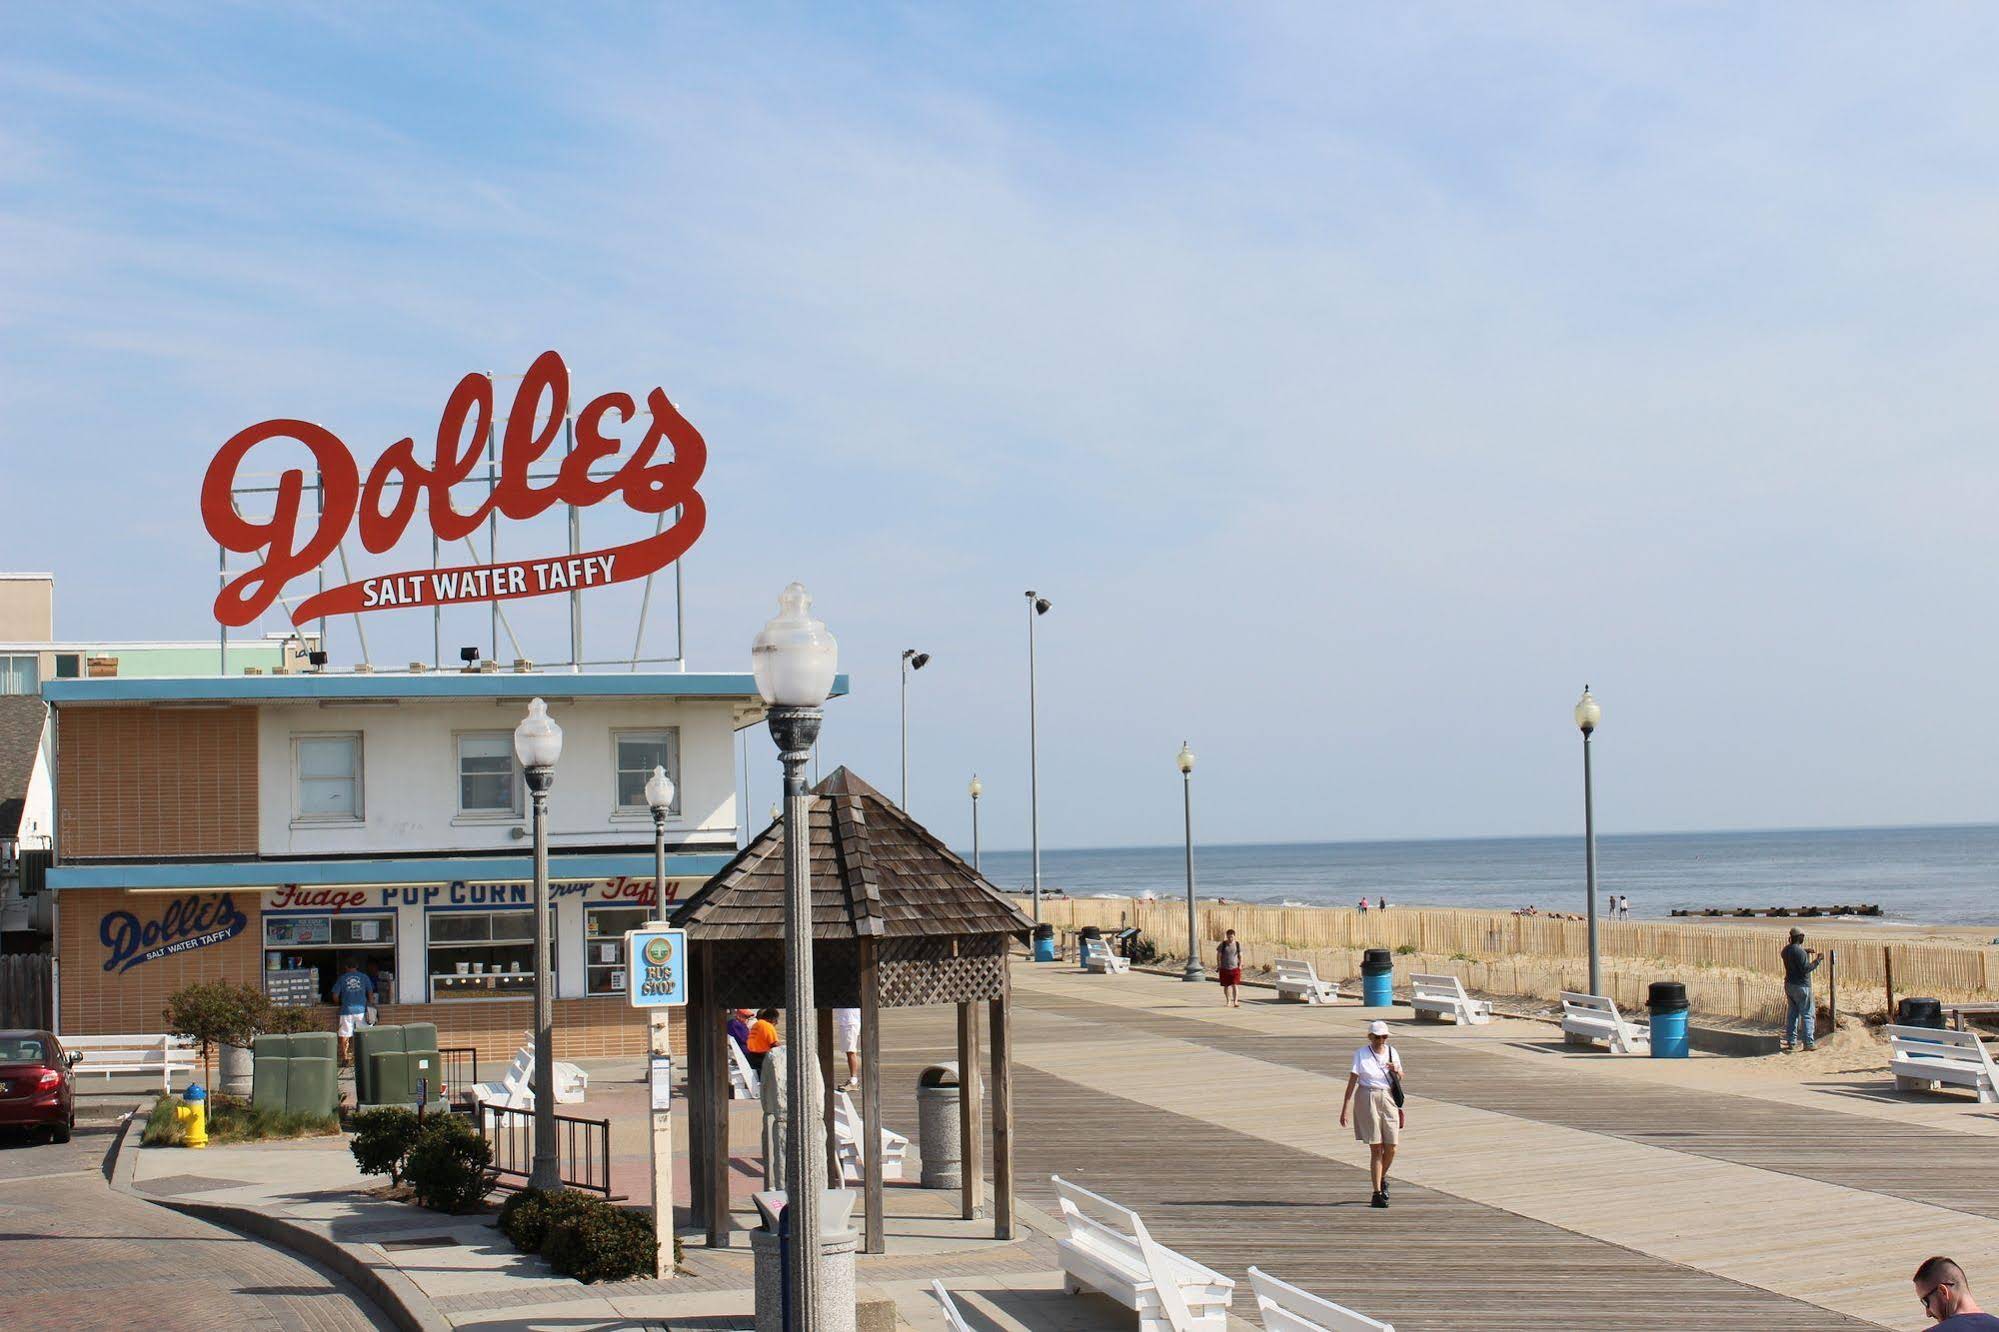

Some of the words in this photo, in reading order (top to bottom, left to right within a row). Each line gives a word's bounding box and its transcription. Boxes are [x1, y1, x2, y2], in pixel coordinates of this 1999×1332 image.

[362, 576, 425, 607] SALT
[431, 565, 528, 601] WATER
[532, 554, 616, 592] TAFFY
[270, 883, 368, 915] Fudge
[146, 948, 165, 961] SALT
[167, 938, 199, 954] WATER
[201, 927, 233, 947] TAFFY
[641, 979, 676, 996] STOP
[646, 966, 672, 980] BUS
